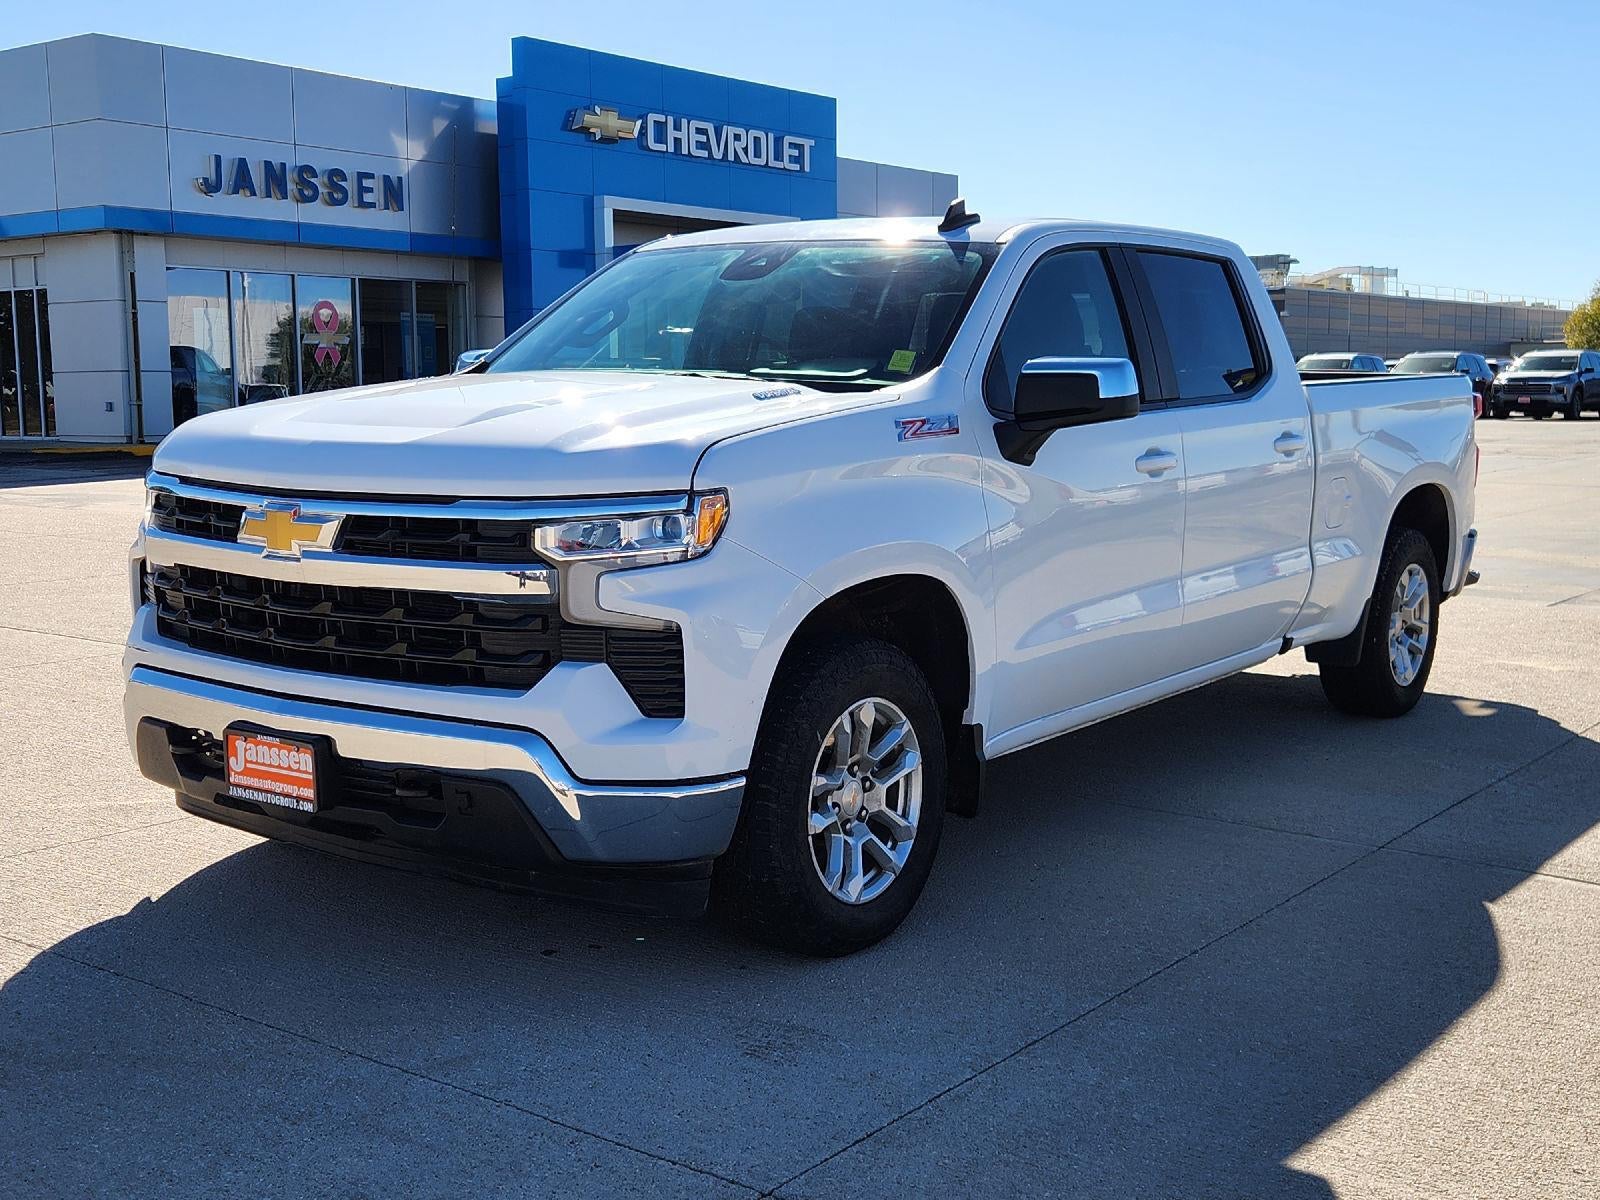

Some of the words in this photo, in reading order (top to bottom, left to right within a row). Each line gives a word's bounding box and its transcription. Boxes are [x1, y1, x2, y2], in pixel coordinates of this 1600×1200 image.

[646, 112, 816, 173] CHEVROLET
[194, 153, 405, 213] JANSSEN
[229, 738, 313, 773] Janssen
[228, 785, 314, 813] JANSSENAUTOGROUP.COM
[229, 771, 314, 799] Janssenautogroup.com
